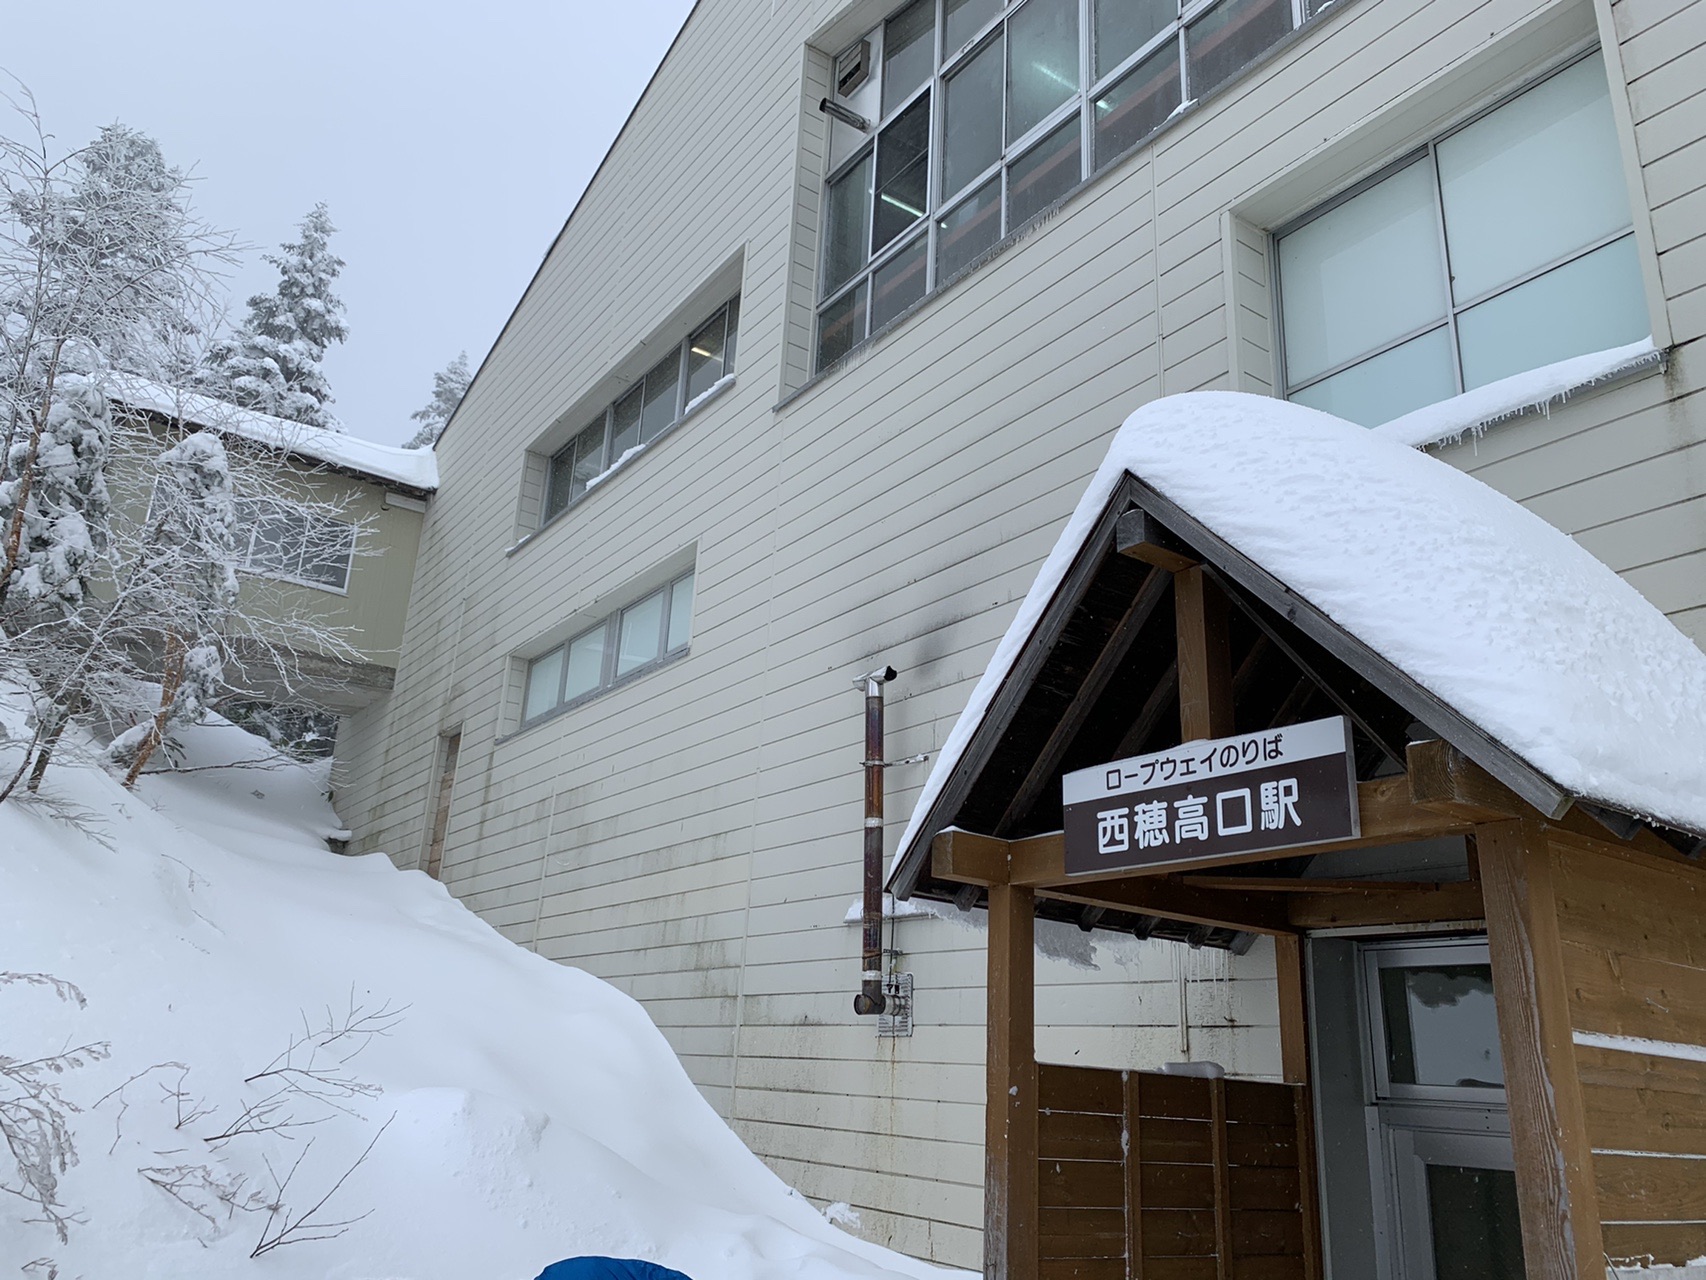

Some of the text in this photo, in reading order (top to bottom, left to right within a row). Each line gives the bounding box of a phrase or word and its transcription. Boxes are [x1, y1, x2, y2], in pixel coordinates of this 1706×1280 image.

[1106, 733, 1284, 790] ロープウェイのりば
[1096, 777, 1302, 855] 西穂高口駅
